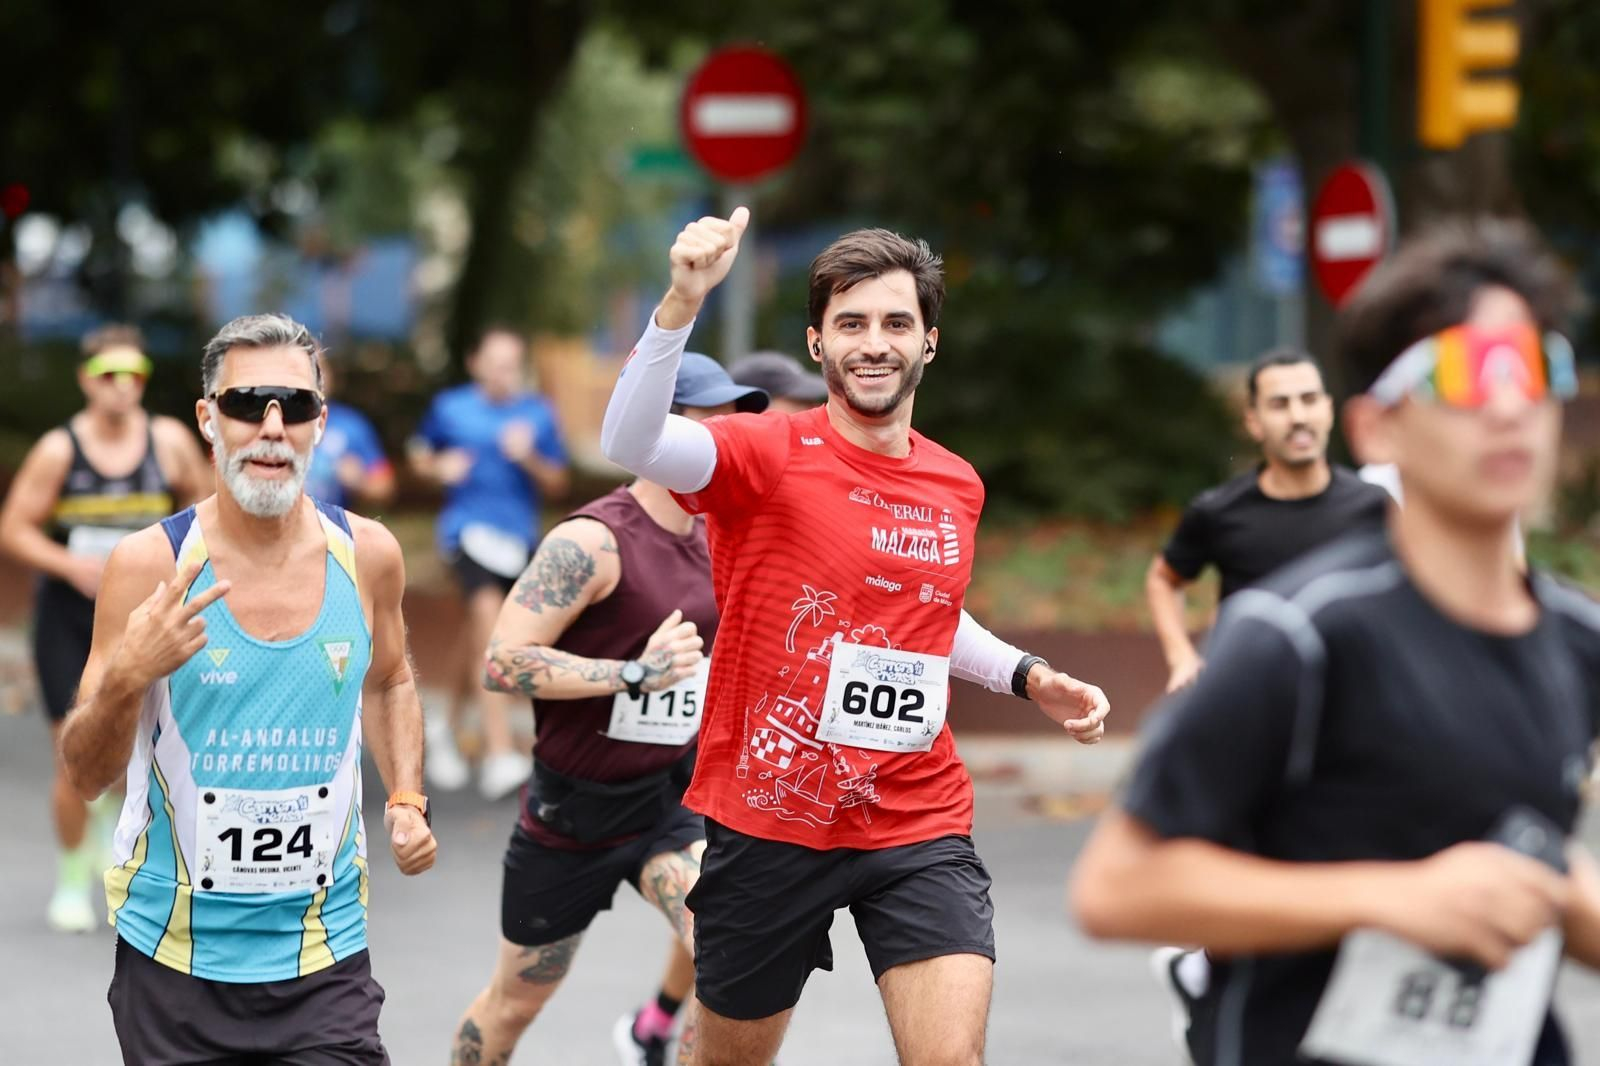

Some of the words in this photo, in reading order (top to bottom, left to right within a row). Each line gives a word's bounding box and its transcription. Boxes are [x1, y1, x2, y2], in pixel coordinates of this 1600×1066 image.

[871, 526, 942, 565] MÁLAGA
[865, 575, 902, 592] málaga
[200, 670, 238, 685] vive
[641, 690, 697, 717] 115
[842, 681, 925, 723] 602
[205, 728, 338, 747] AL-ANDALUS
[217, 824, 314, 862] 124
